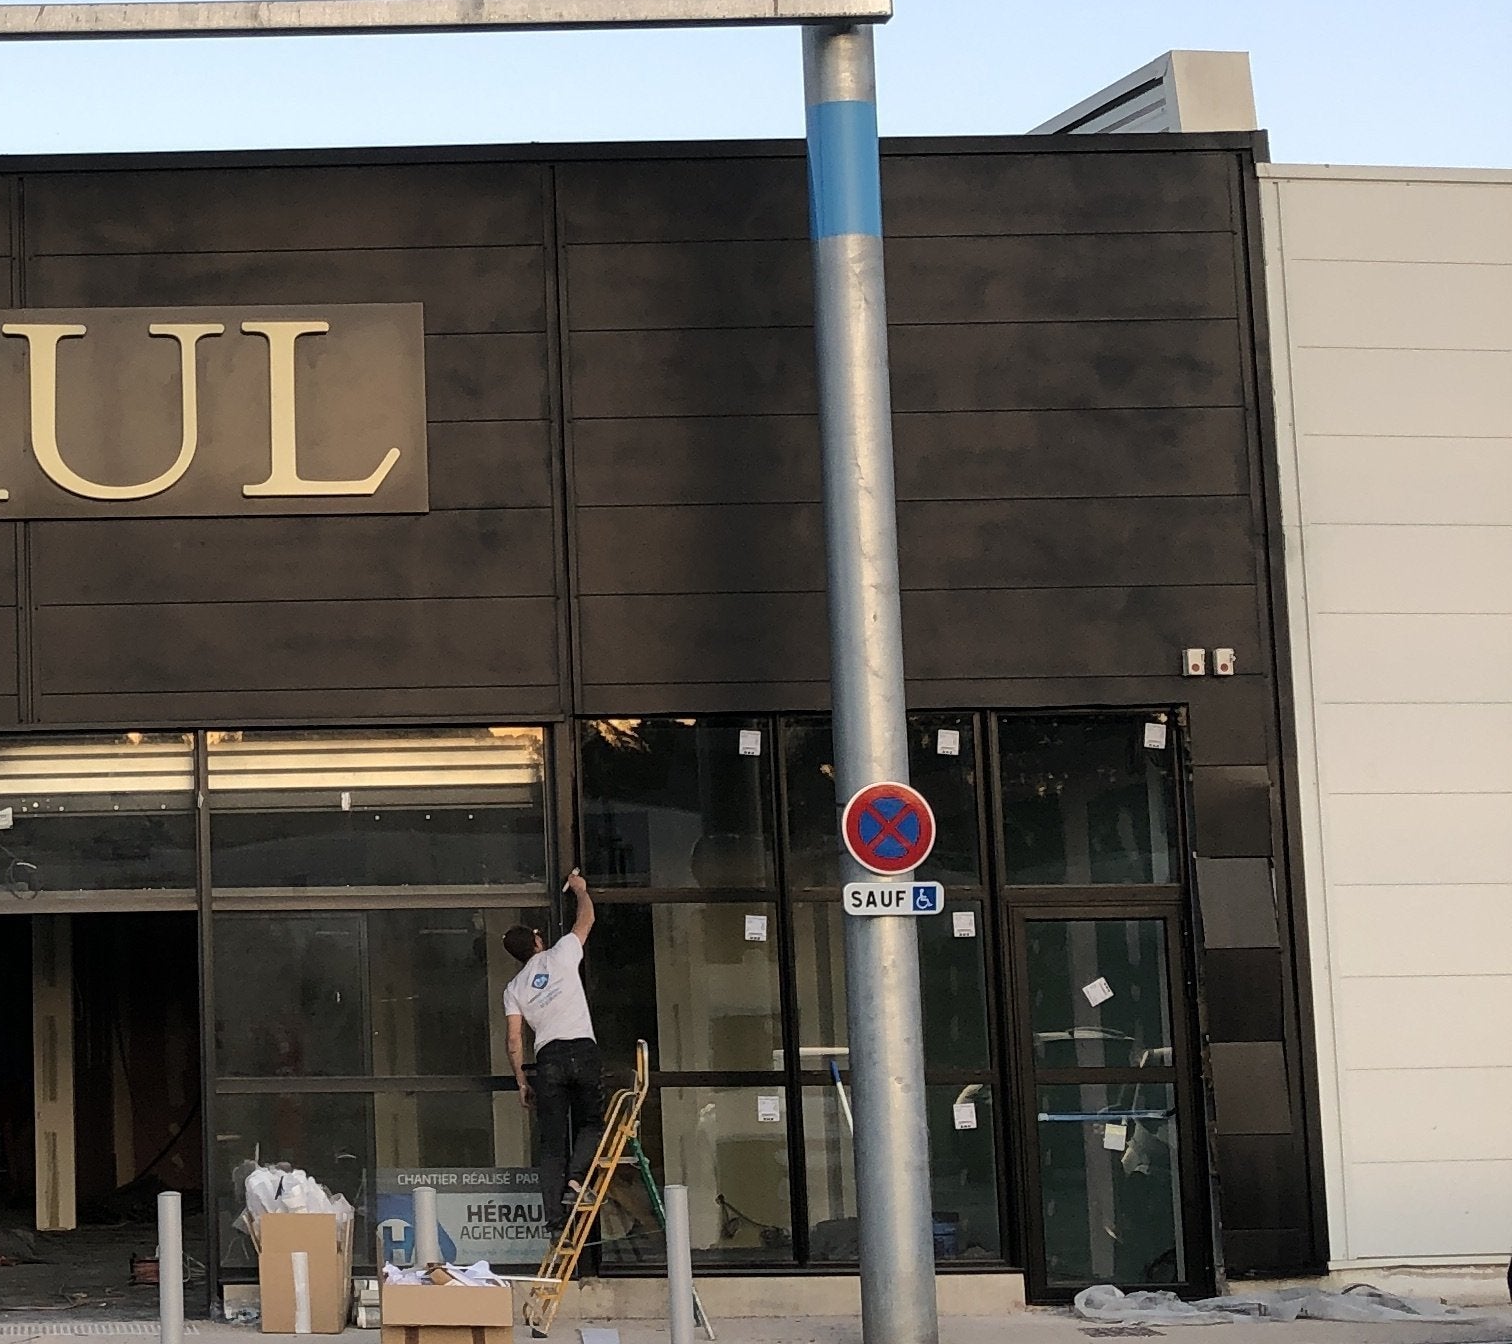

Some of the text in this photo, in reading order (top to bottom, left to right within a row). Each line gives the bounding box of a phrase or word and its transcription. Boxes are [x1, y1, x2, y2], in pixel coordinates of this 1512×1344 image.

[851, 890, 906, 908] SAUF
[397, 1171, 539, 1185] CHANTIER RÉALISÉ PAR
[460, 1226, 552, 1239] AGENCEME
